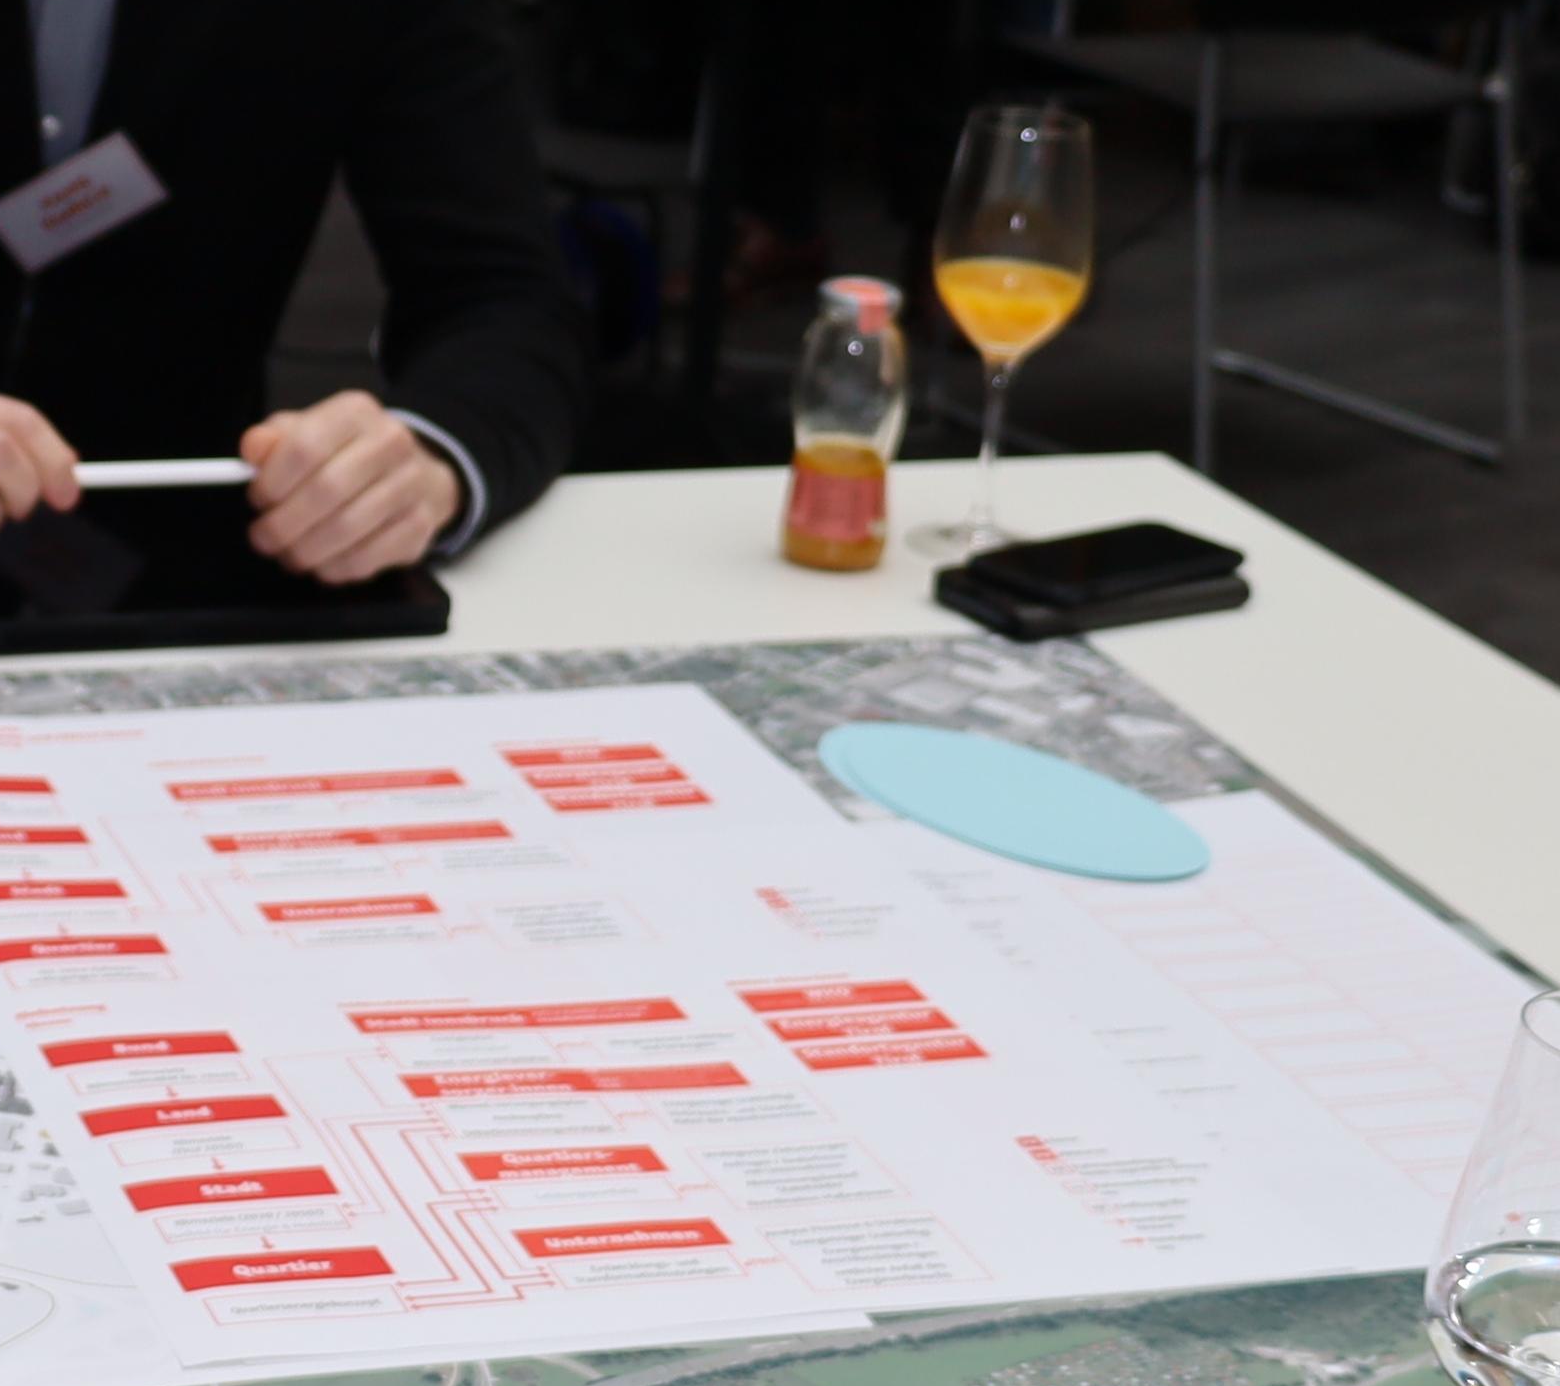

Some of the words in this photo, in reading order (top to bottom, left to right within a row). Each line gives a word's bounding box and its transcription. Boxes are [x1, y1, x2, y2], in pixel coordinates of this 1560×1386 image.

[156, 1105, 213, 1121] Land
[199, 1180, 265, 1198] Stadt
[542, 1228, 704, 1251] Unternehmen
[232, 1258, 335, 1280] Quartier
